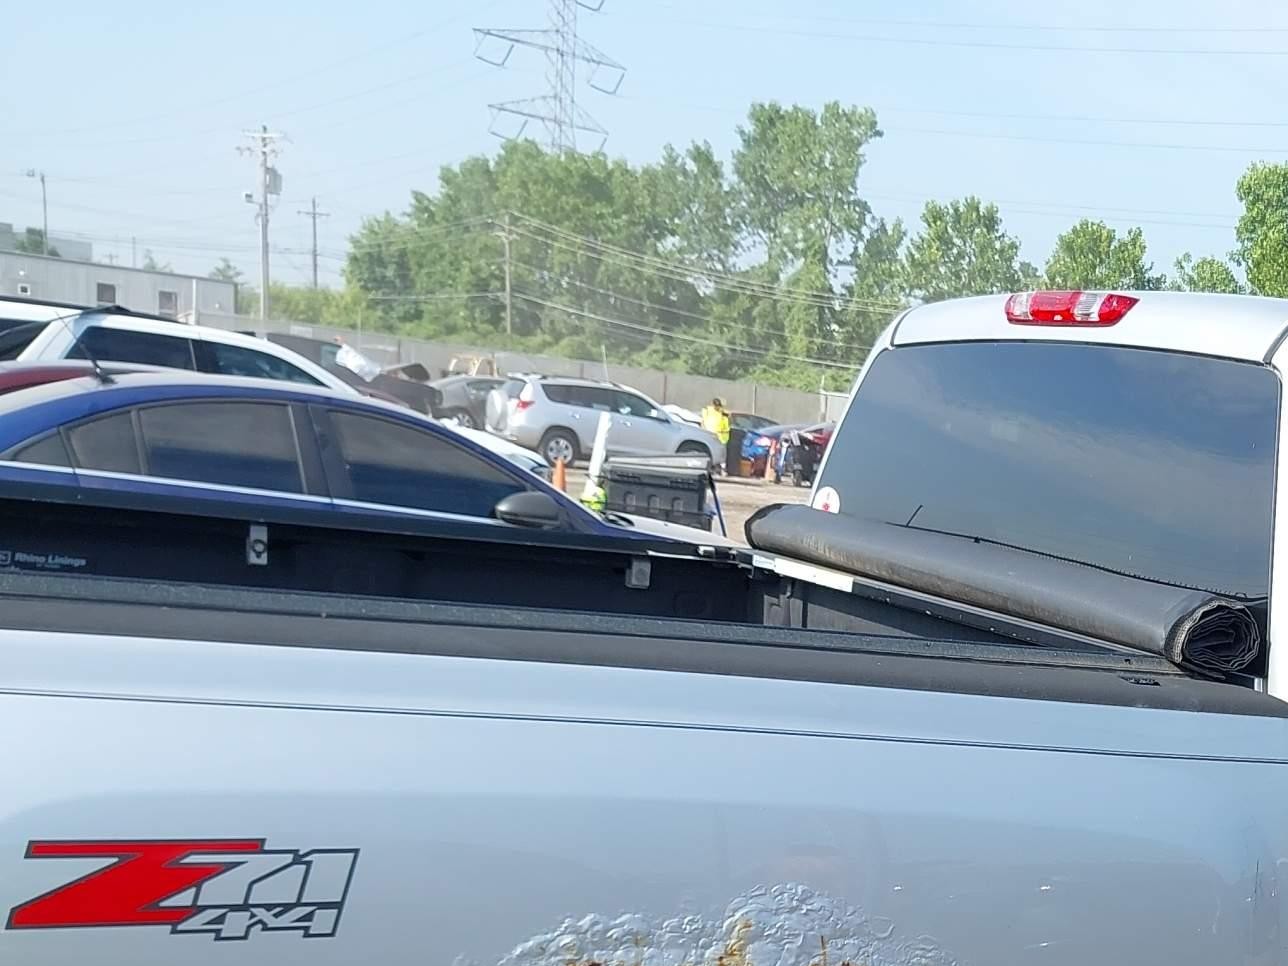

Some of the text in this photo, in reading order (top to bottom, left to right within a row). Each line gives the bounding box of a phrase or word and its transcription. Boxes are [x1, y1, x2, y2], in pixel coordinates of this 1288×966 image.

[14, 552, 46, 563] Rhino
[48, 554, 87, 567] Linings
[4, 838, 361, 930] Z71
